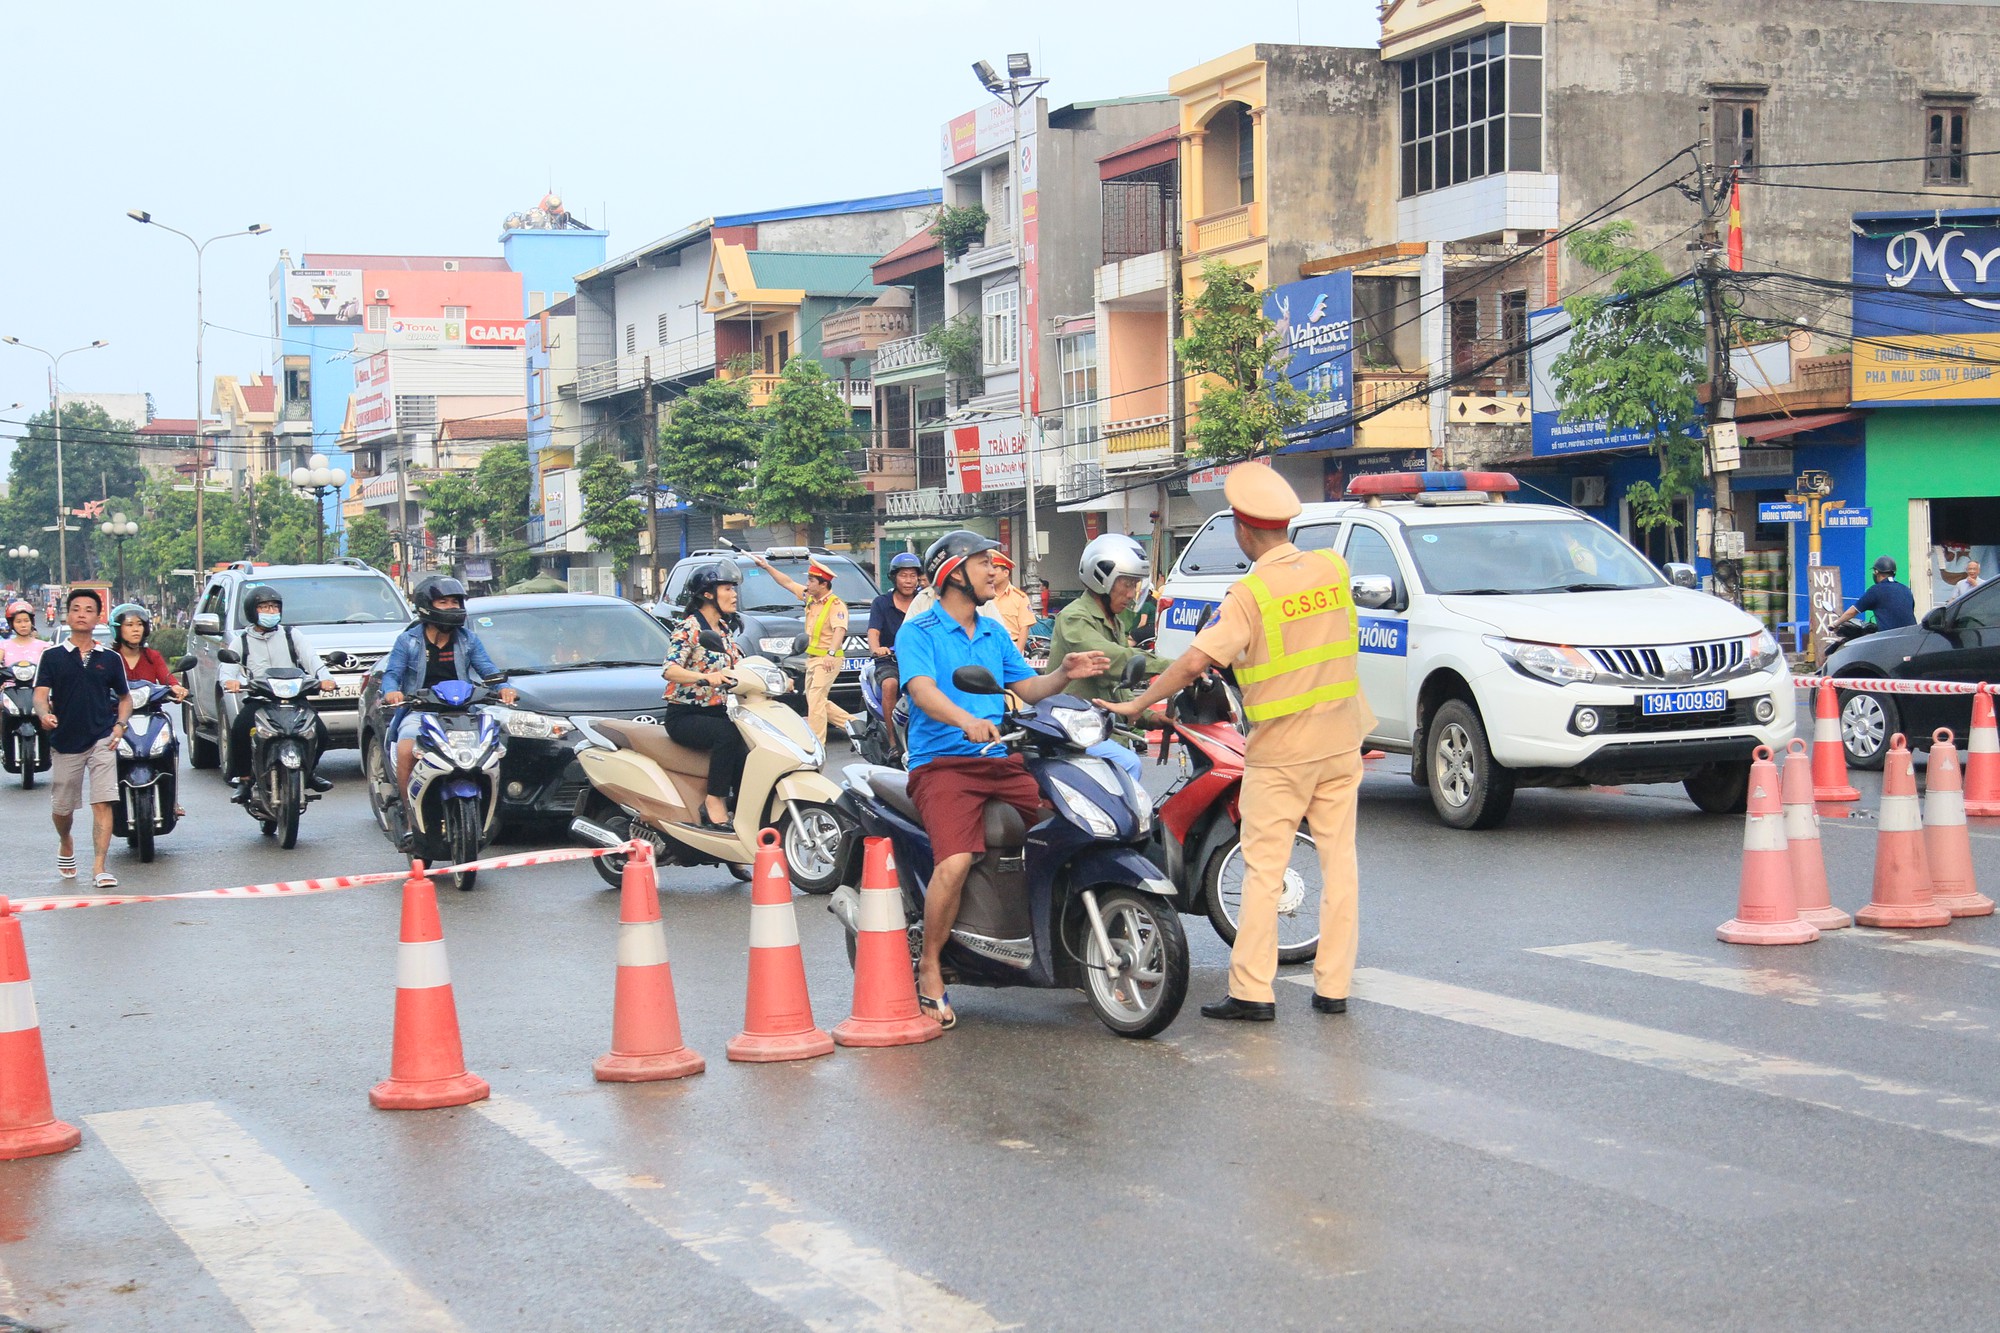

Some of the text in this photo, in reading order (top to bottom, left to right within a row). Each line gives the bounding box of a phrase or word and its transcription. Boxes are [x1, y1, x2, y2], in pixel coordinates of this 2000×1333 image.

[405, 323, 440, 332] TOTAL
[1289, 320, 1350, 355] Valpasee
[1875, 347, 1909, 362] TRUNG
[1865, 363, 1991, 383] PHA MÀU SƠN TỰ ĐỘNG
[1551, 427, 1561, 436] PHA
[1402, 458, 1425, 470] Valpasee
[1828, 516, 1839, 525] HAI
[1840, 514, 1848, 525] BÀ
[1813, 570, 1835, 588] NƠI
[1281, 587, 1340, 617] C.S.G.T
[1172, 601, 1200, 626] CẢNH
[1647, 691, 1723, 712] 19A-009.96
[1210, 771, 1233, 780] HONDA
[1027, 838, 1048, 846] HONDA
